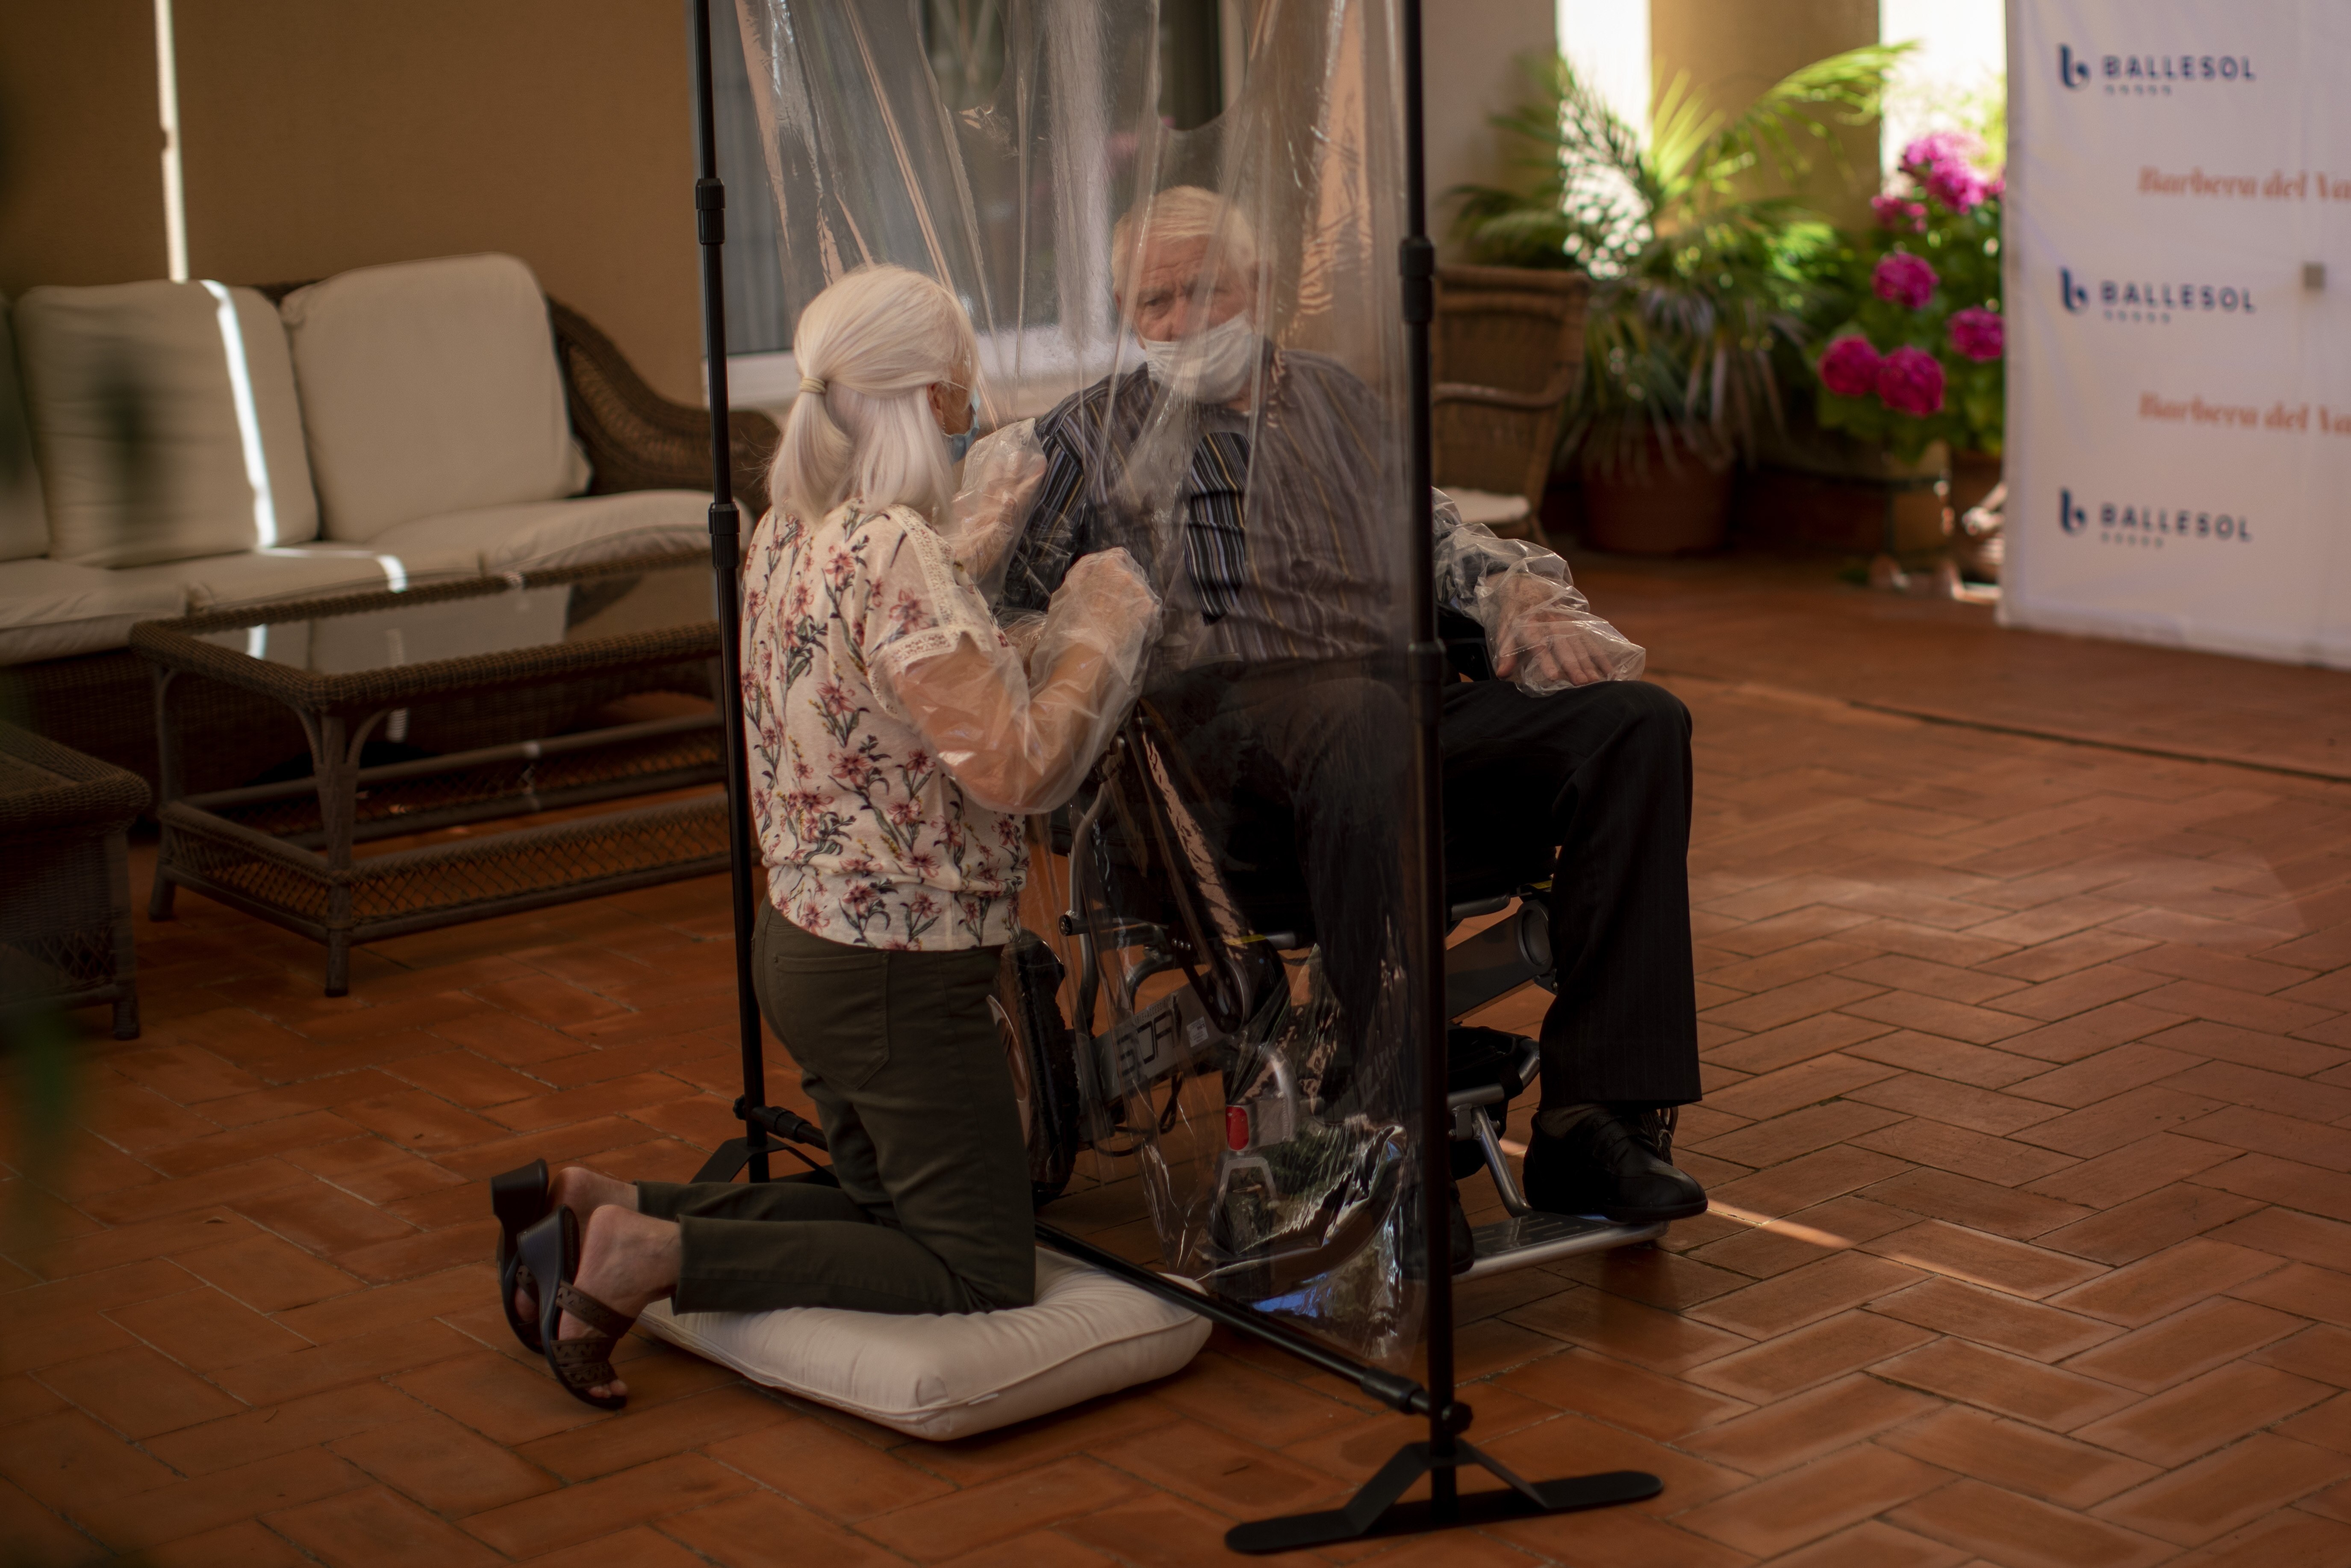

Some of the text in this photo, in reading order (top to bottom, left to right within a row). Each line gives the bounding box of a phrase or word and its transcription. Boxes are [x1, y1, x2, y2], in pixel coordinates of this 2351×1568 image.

[2103, 56, 2254, 80] BALLESOL
[2262, 172, 2307, 198] del
[2101, 281, 2254, 313] BALLESOL
[2263, 401, 2308, 431] del
[2100, 503, 2251, 542] BALLESOL
